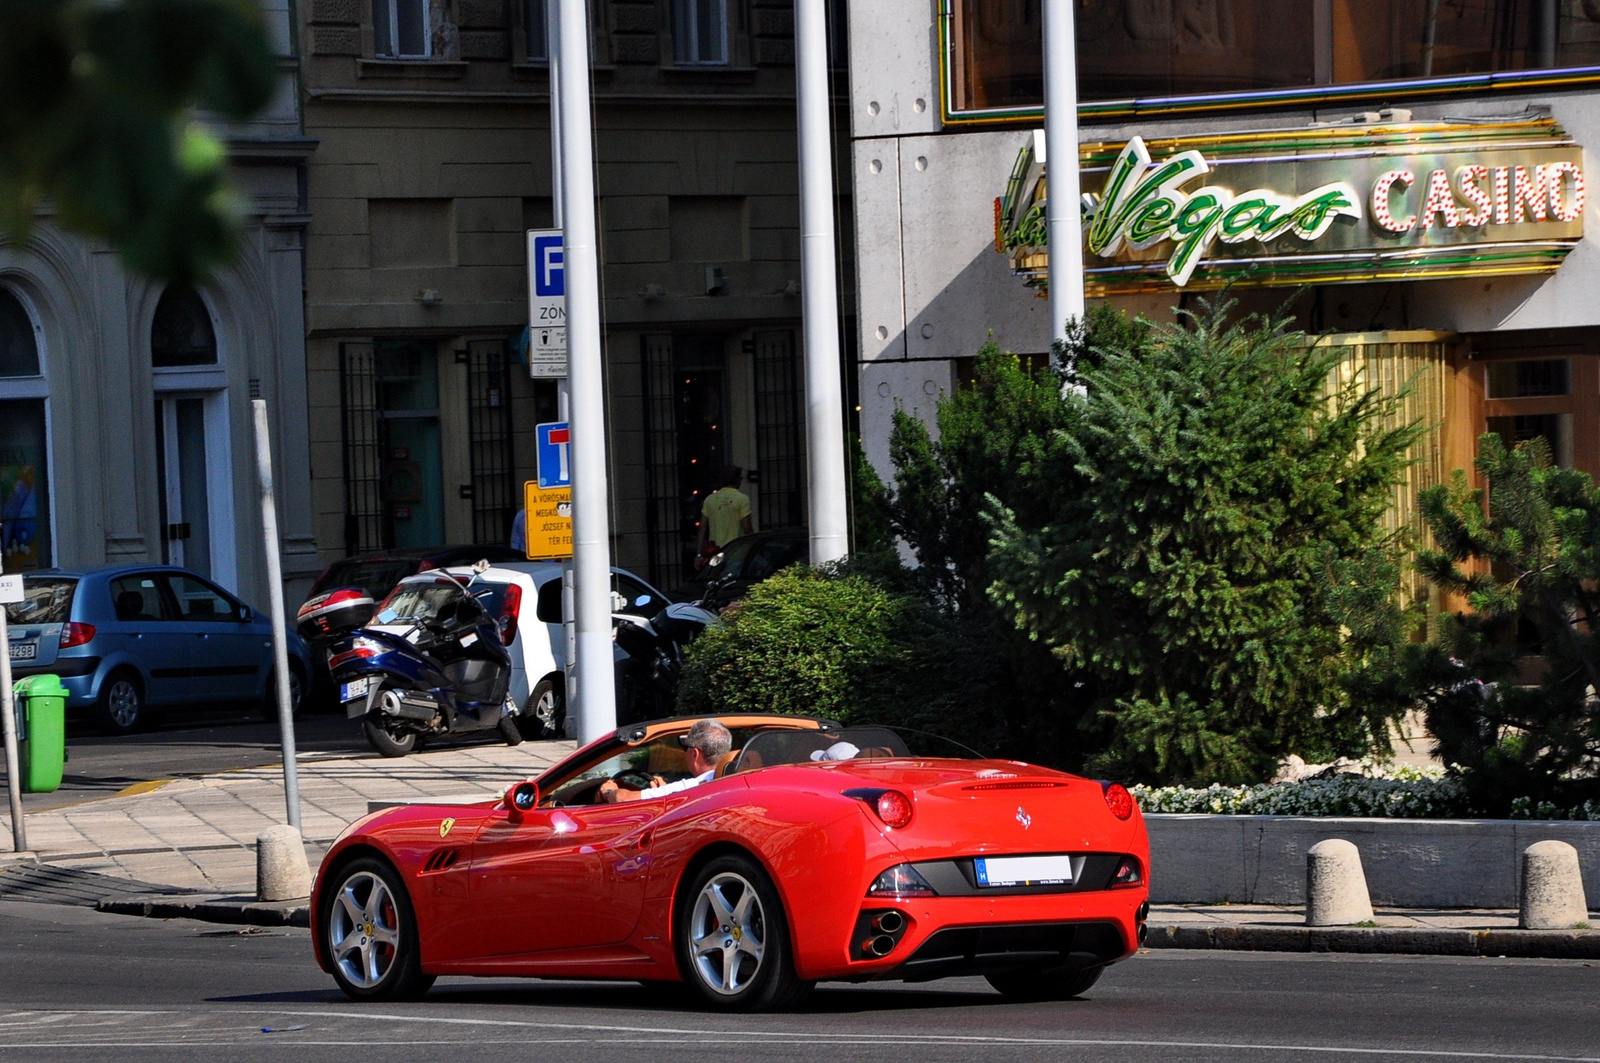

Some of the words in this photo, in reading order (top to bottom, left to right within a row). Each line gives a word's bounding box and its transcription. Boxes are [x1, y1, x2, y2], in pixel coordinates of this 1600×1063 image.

[1088, 135, 1362, 286] Vegas
[1370, 161, 1584, 232] CASINO
[539, 493, 571, 503] VÖRÖSMA
[548, 535, 560, 545] TÉR
